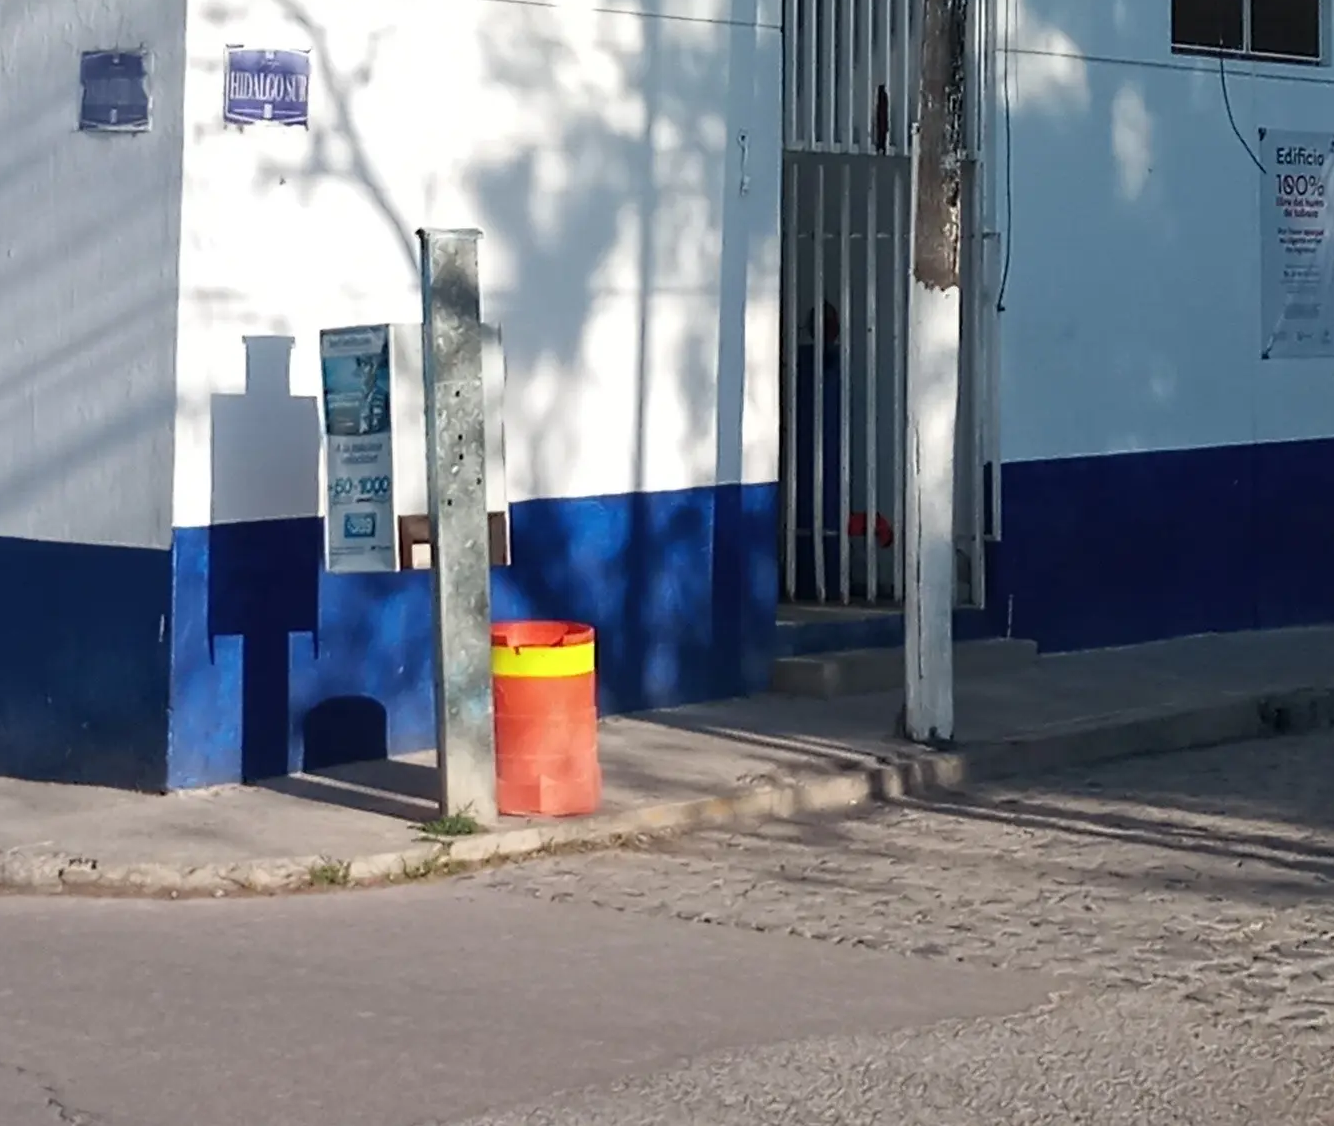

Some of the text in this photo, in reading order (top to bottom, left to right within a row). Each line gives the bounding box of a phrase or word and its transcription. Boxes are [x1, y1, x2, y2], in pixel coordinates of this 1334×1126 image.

[229, 70, 285, 101] HIDALGO
[1276, 147, 1324, 167] Edificio
[1276, 173, 1325, 197] 100%
